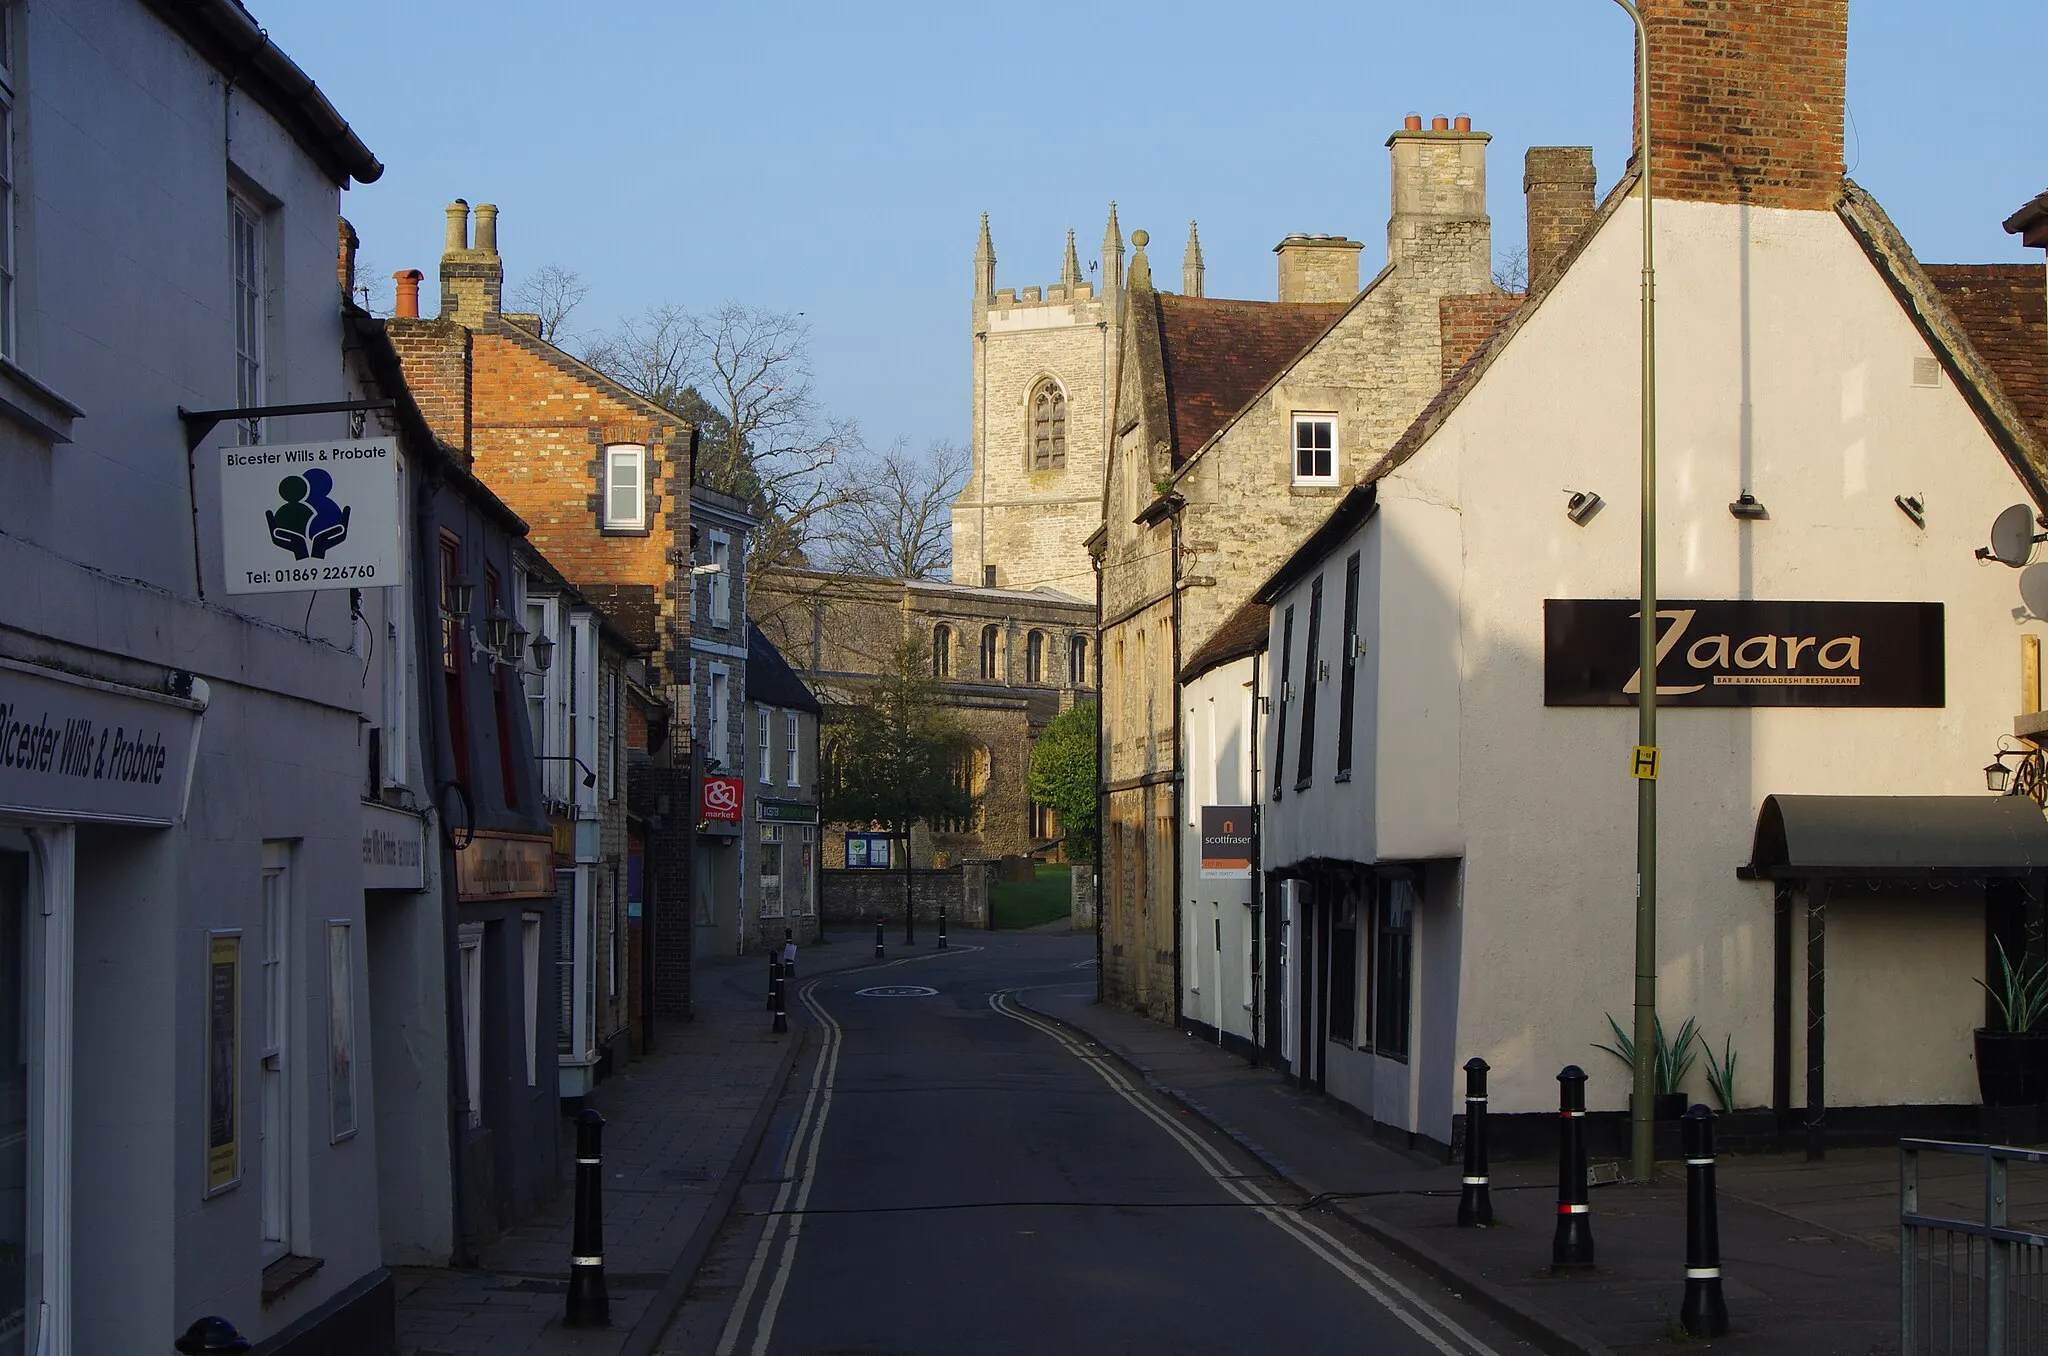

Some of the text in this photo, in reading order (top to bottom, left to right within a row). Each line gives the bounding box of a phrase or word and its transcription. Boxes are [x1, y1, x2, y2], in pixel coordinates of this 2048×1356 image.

[227, 446, 387, 466] Bicester Wills & Probate
[246, 565, 375, 584] Tel: 01869 226760
[1622, 609, 1861, 695] Zaara
[59, 718, 95, 778] Wills
[93, 727, 109, 780] &
[107, 727, 166, 785] Probate
[705, 810, 735, 819] market
[1205, 834, 1251, 844] scottfraser
